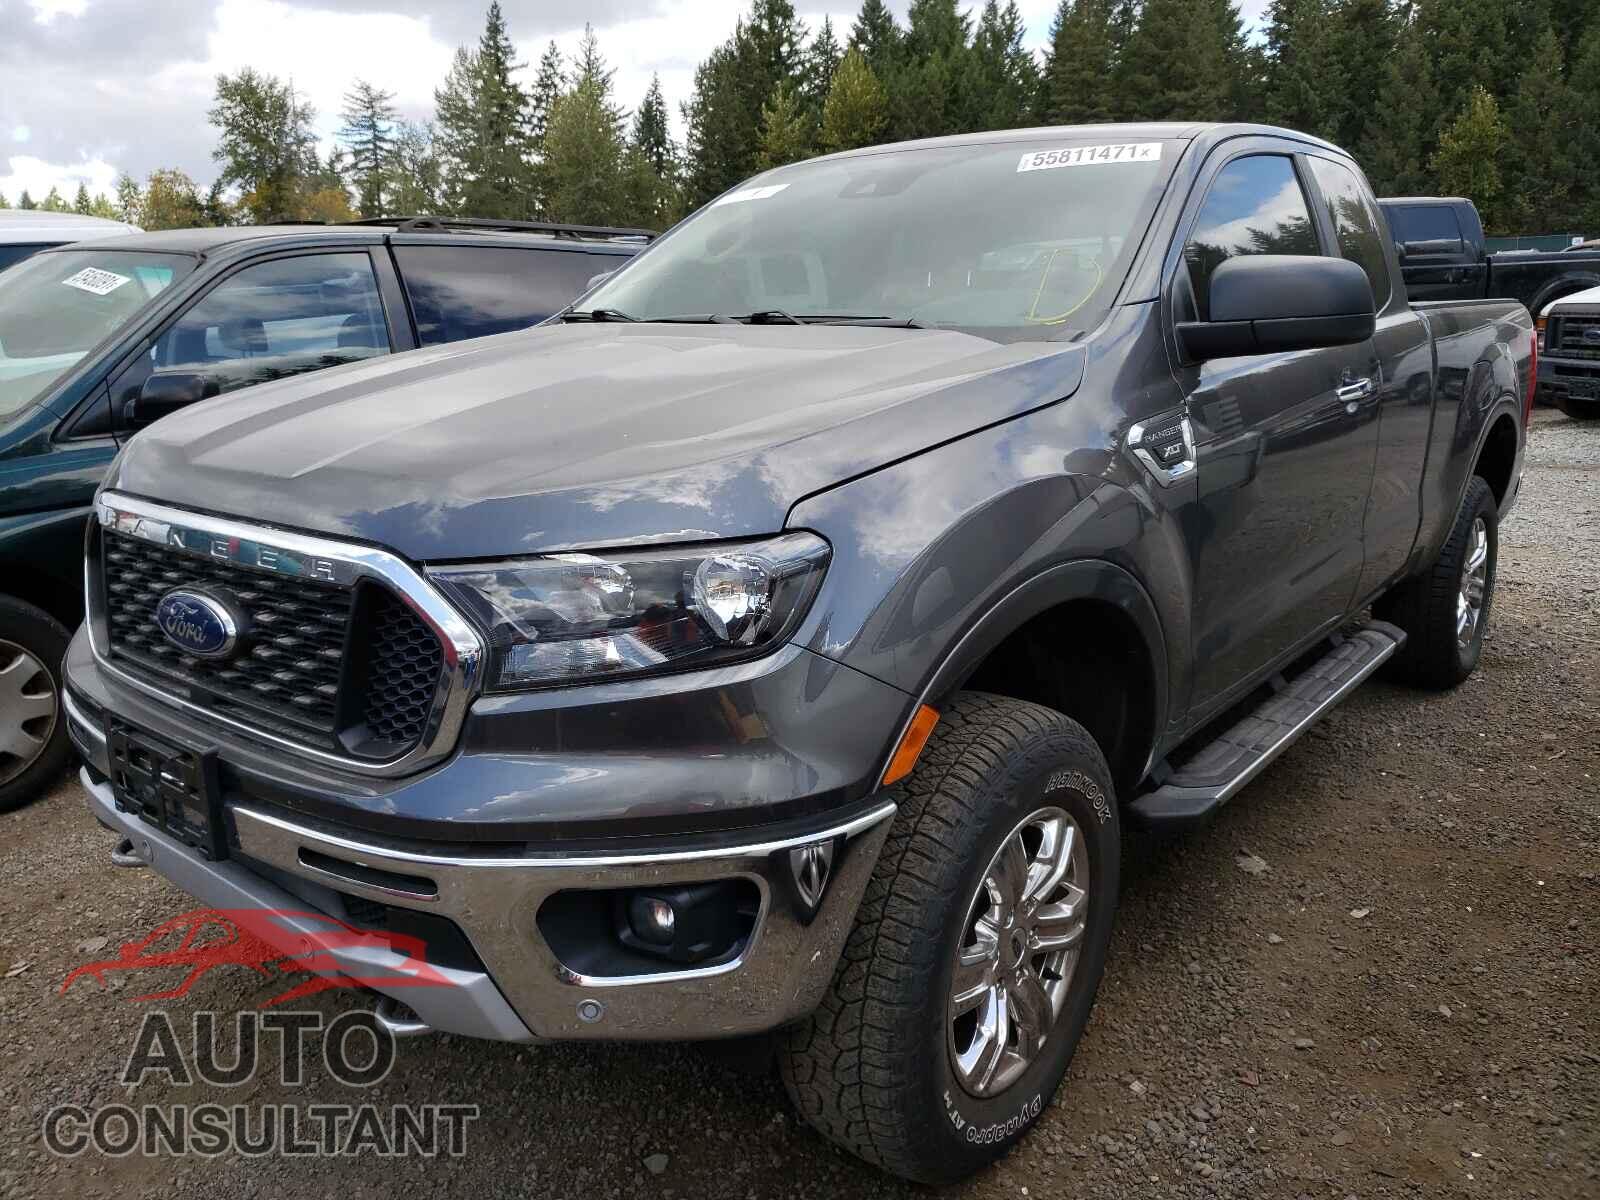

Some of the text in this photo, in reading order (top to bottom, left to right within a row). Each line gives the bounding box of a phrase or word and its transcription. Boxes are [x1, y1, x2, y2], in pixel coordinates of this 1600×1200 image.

[1143, 424, 1182, 441] RANGER
[1163, 442, 1183, 458] XLT
[102, 506, 336, 581] RANGER
[167, 601, 208, 644] Ford
[966, 1093, 1041, 1144] Dynapro
